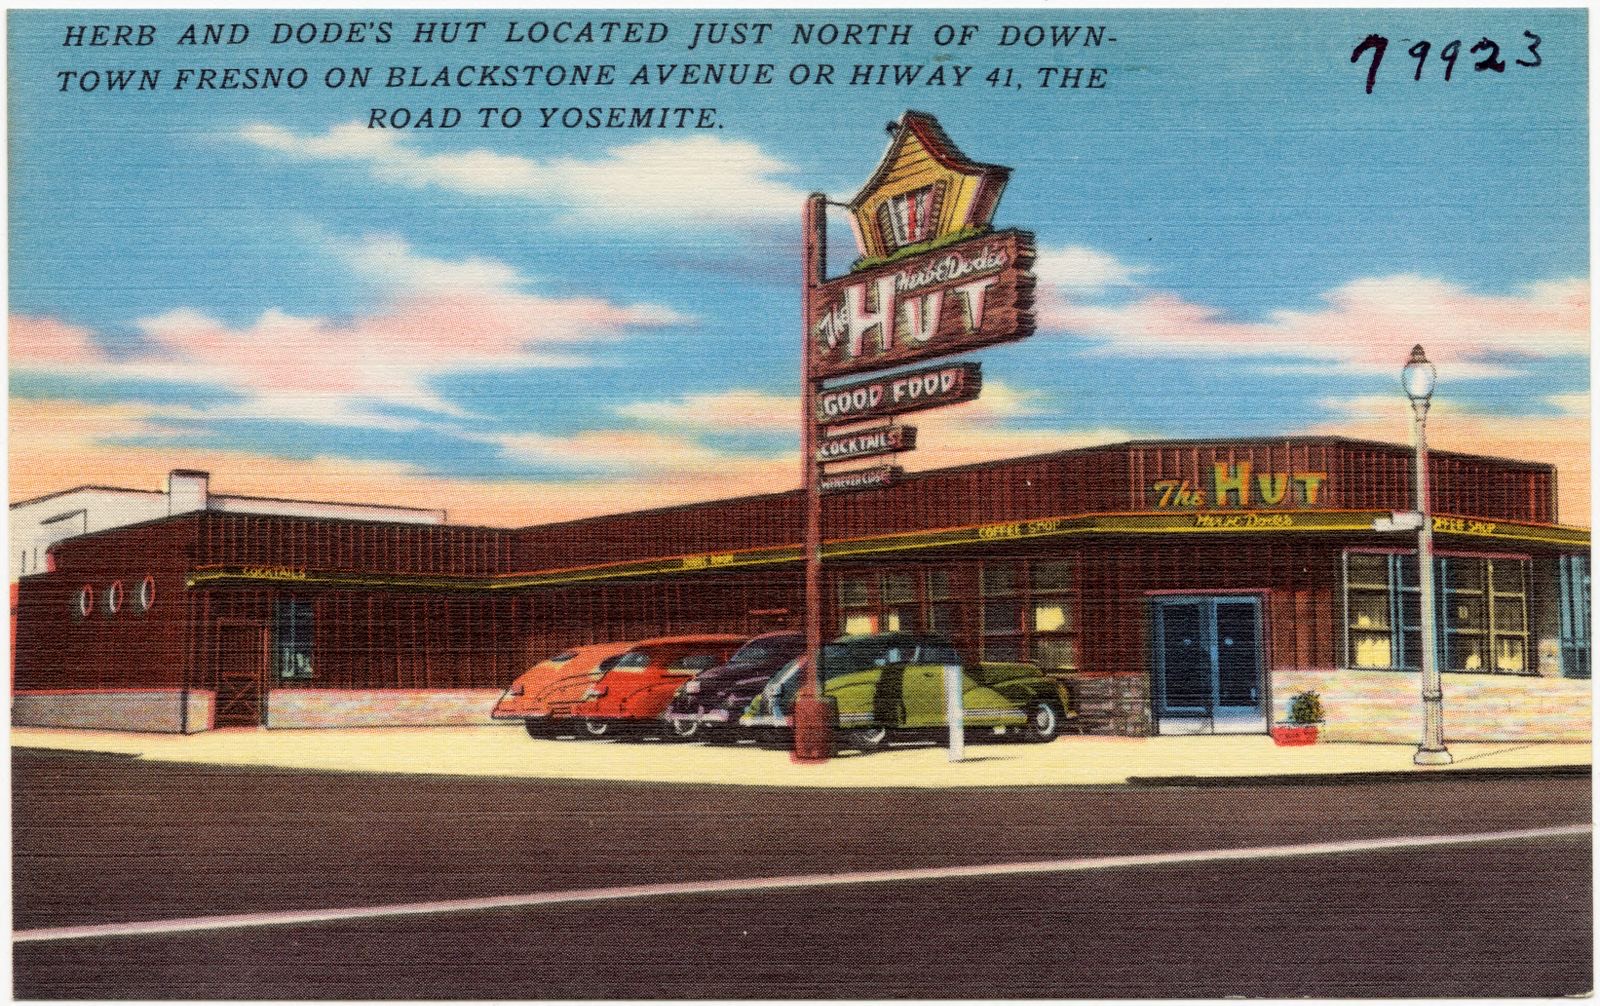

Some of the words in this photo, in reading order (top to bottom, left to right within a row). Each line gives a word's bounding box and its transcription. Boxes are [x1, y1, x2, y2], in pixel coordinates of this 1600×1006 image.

[1350, 30, 1542, 94] 79923
[819, 303, 850, 349] The
[845, 274, 999, 357] HUT
[823, 384, 883, 416] GOOD
[892, 369, 957, 403] FOOD
[820, 431, 897, 456] COCKTAILS
[1153, 479, 1206, 508] The
[1212, 461, 1328, 507] HUT
[978, 523, 1021, 540] COFFEE
[1028, 519, 1060, 534] SHOP
